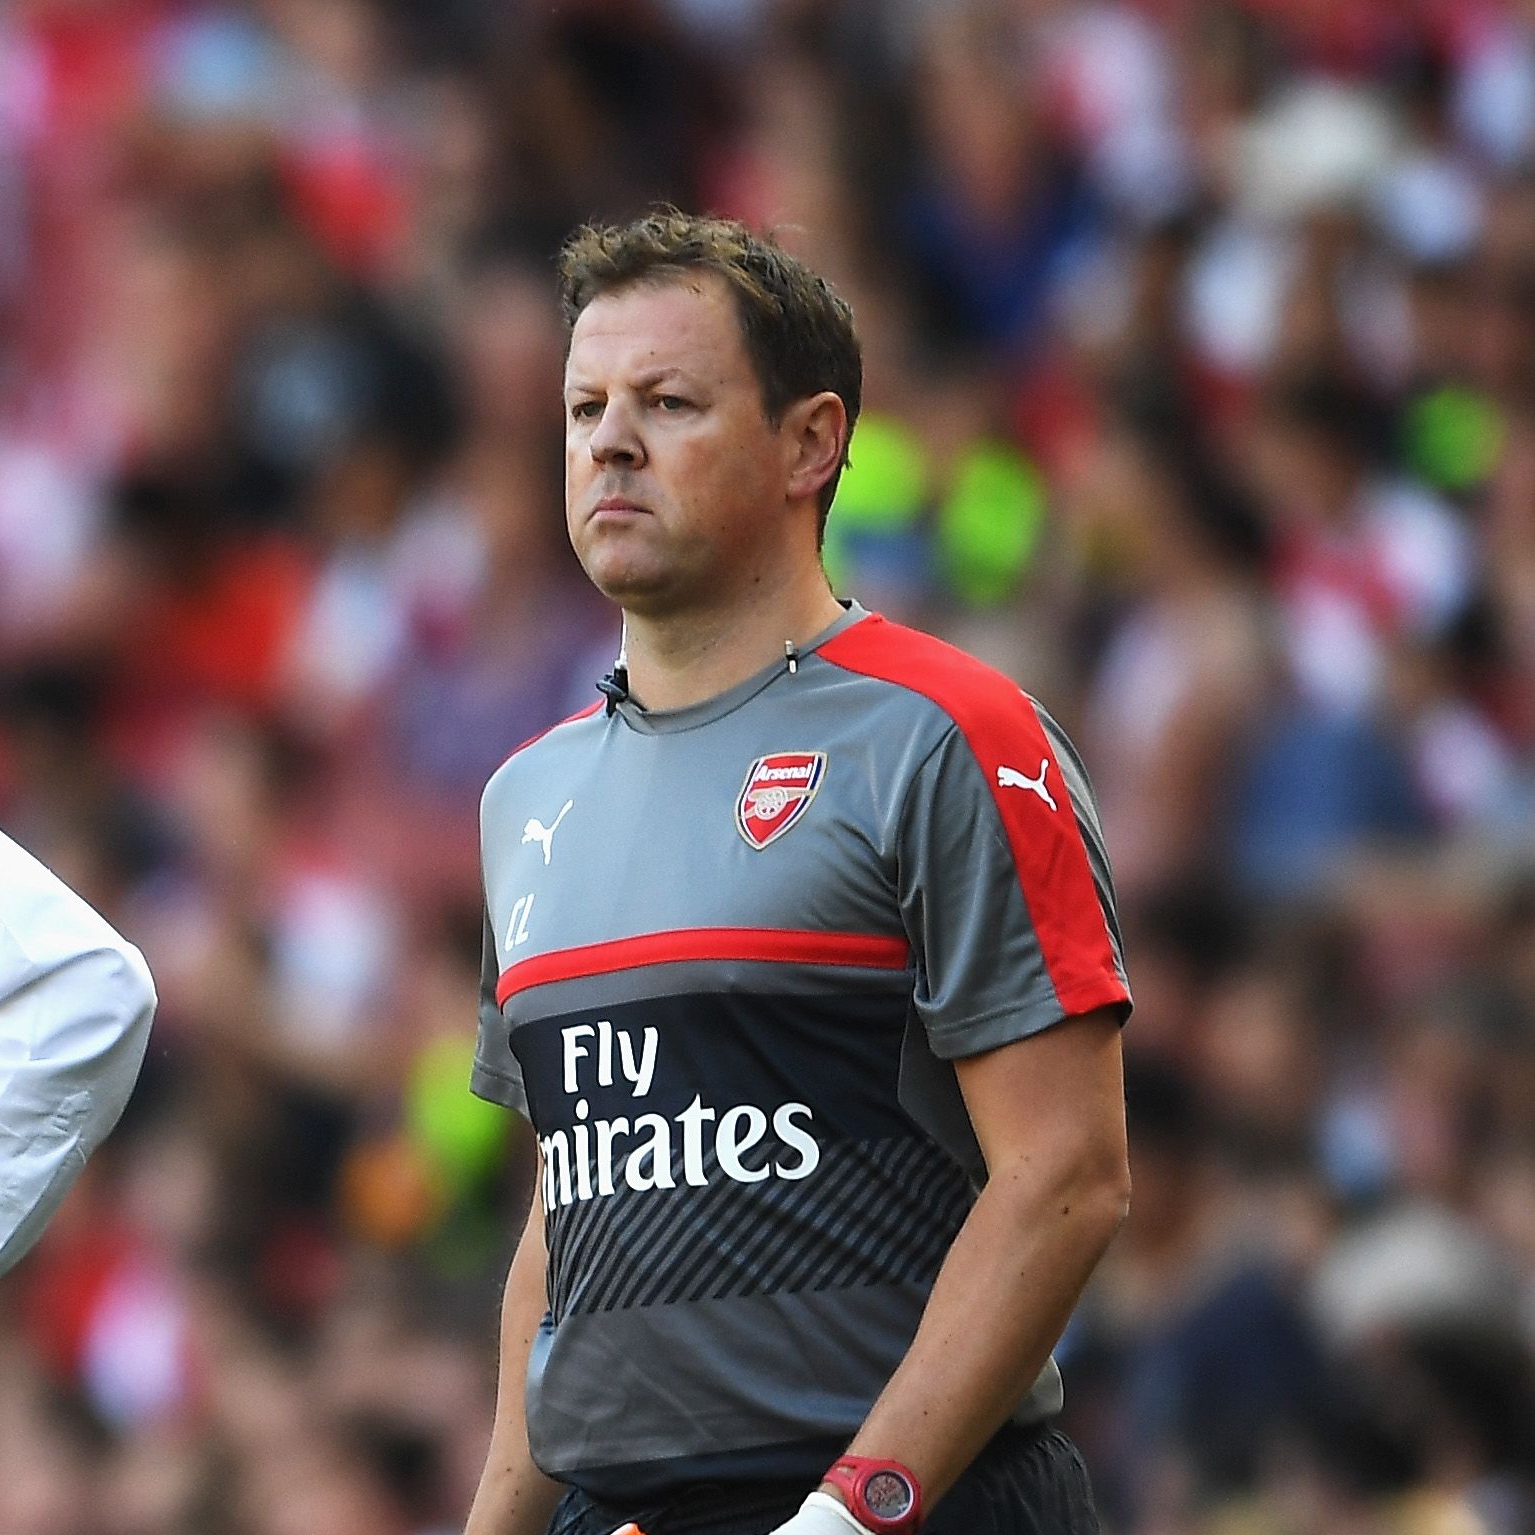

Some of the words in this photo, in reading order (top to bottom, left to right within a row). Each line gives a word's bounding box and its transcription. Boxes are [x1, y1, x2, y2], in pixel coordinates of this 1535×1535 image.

[754, 763, 812, 782] Arsenal
[561, 1021, 658, 1097] Fly
[537, 1093, 820, 1216] mirates
